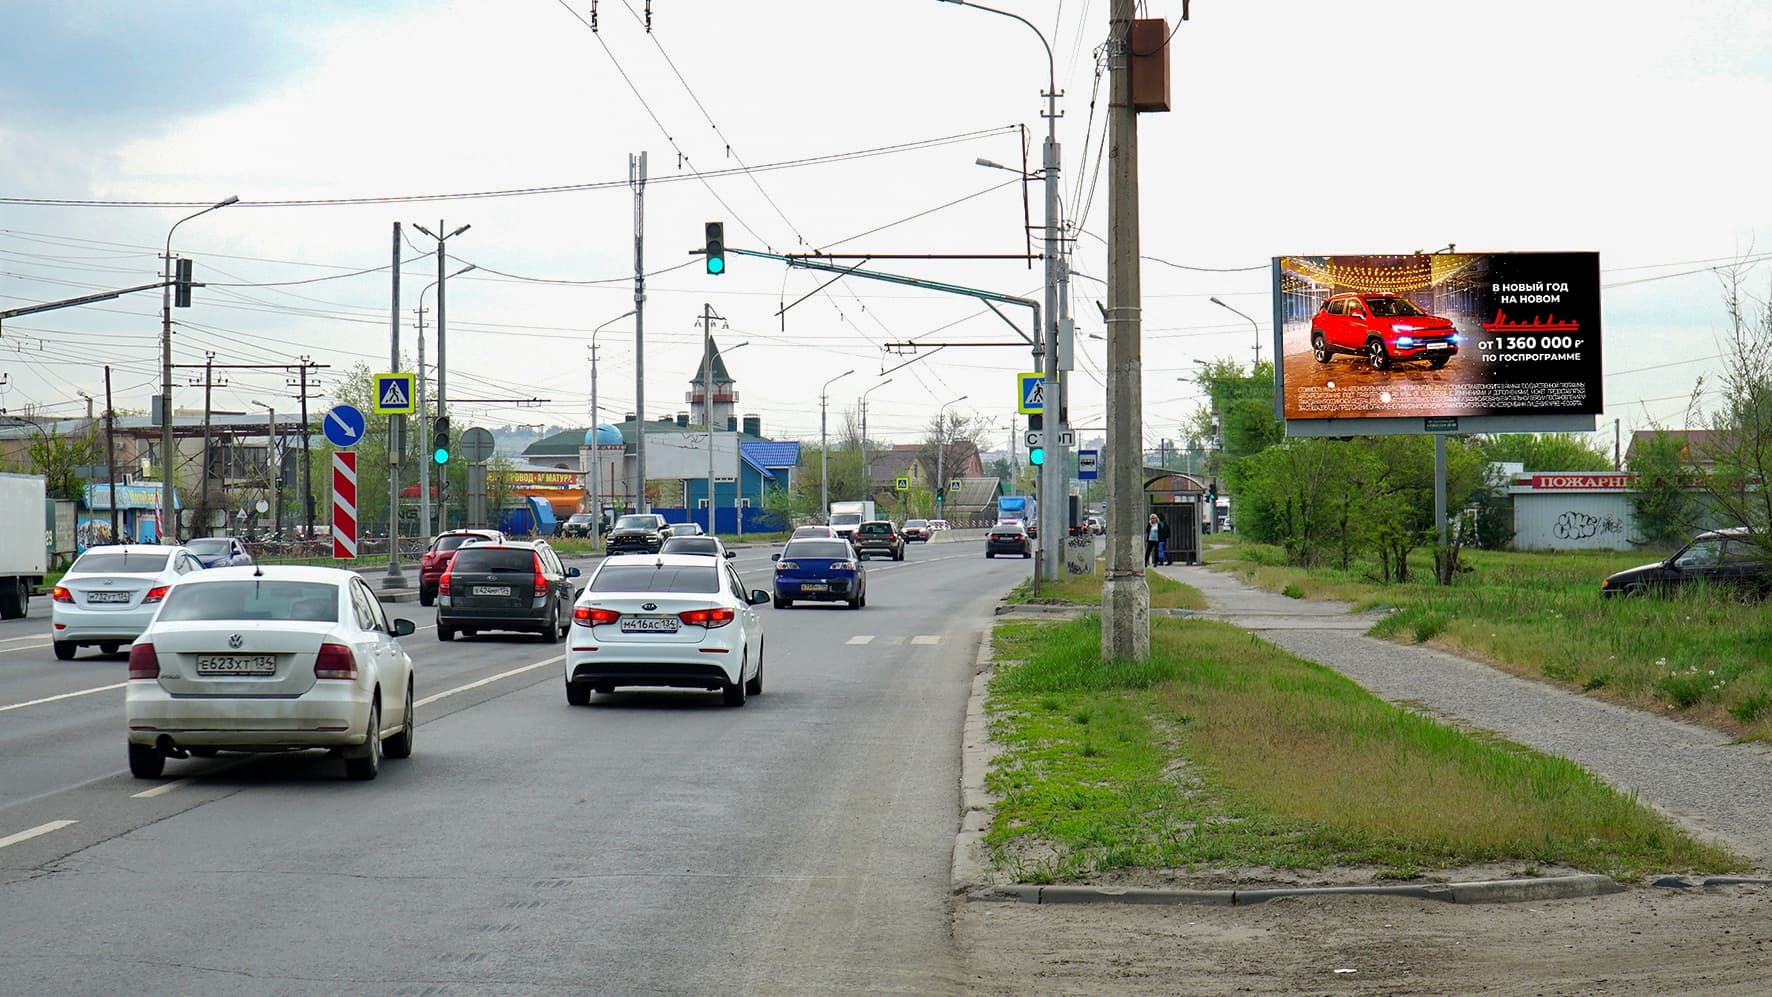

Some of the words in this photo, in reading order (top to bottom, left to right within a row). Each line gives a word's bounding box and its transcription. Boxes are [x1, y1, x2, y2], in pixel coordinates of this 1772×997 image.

[1492, 283, 1500, 292] В
[1502, 281, 1543, 292] НОВЫЙ
[1546, 283, 1569, 292] ГОД
[1501, 295, 1517, 304] НА
[1520, 295, 1560, 304] НОВОМ
[1495, 337, 1503, 350] 1
[1506, 337, 1537, 350] 360
[1541, 336, 1572, 349] 000
[1482, 354, 1497, 362] ПО
[1499, 353, 1581, 362] ГОСПРОГРАММЕ
[623, 620, 659, 629] М416АС
[661, 619, 676, 627] 134
[201, 657, 251, 670] Е623ХТ
[254, 657, 273, 667] 134
